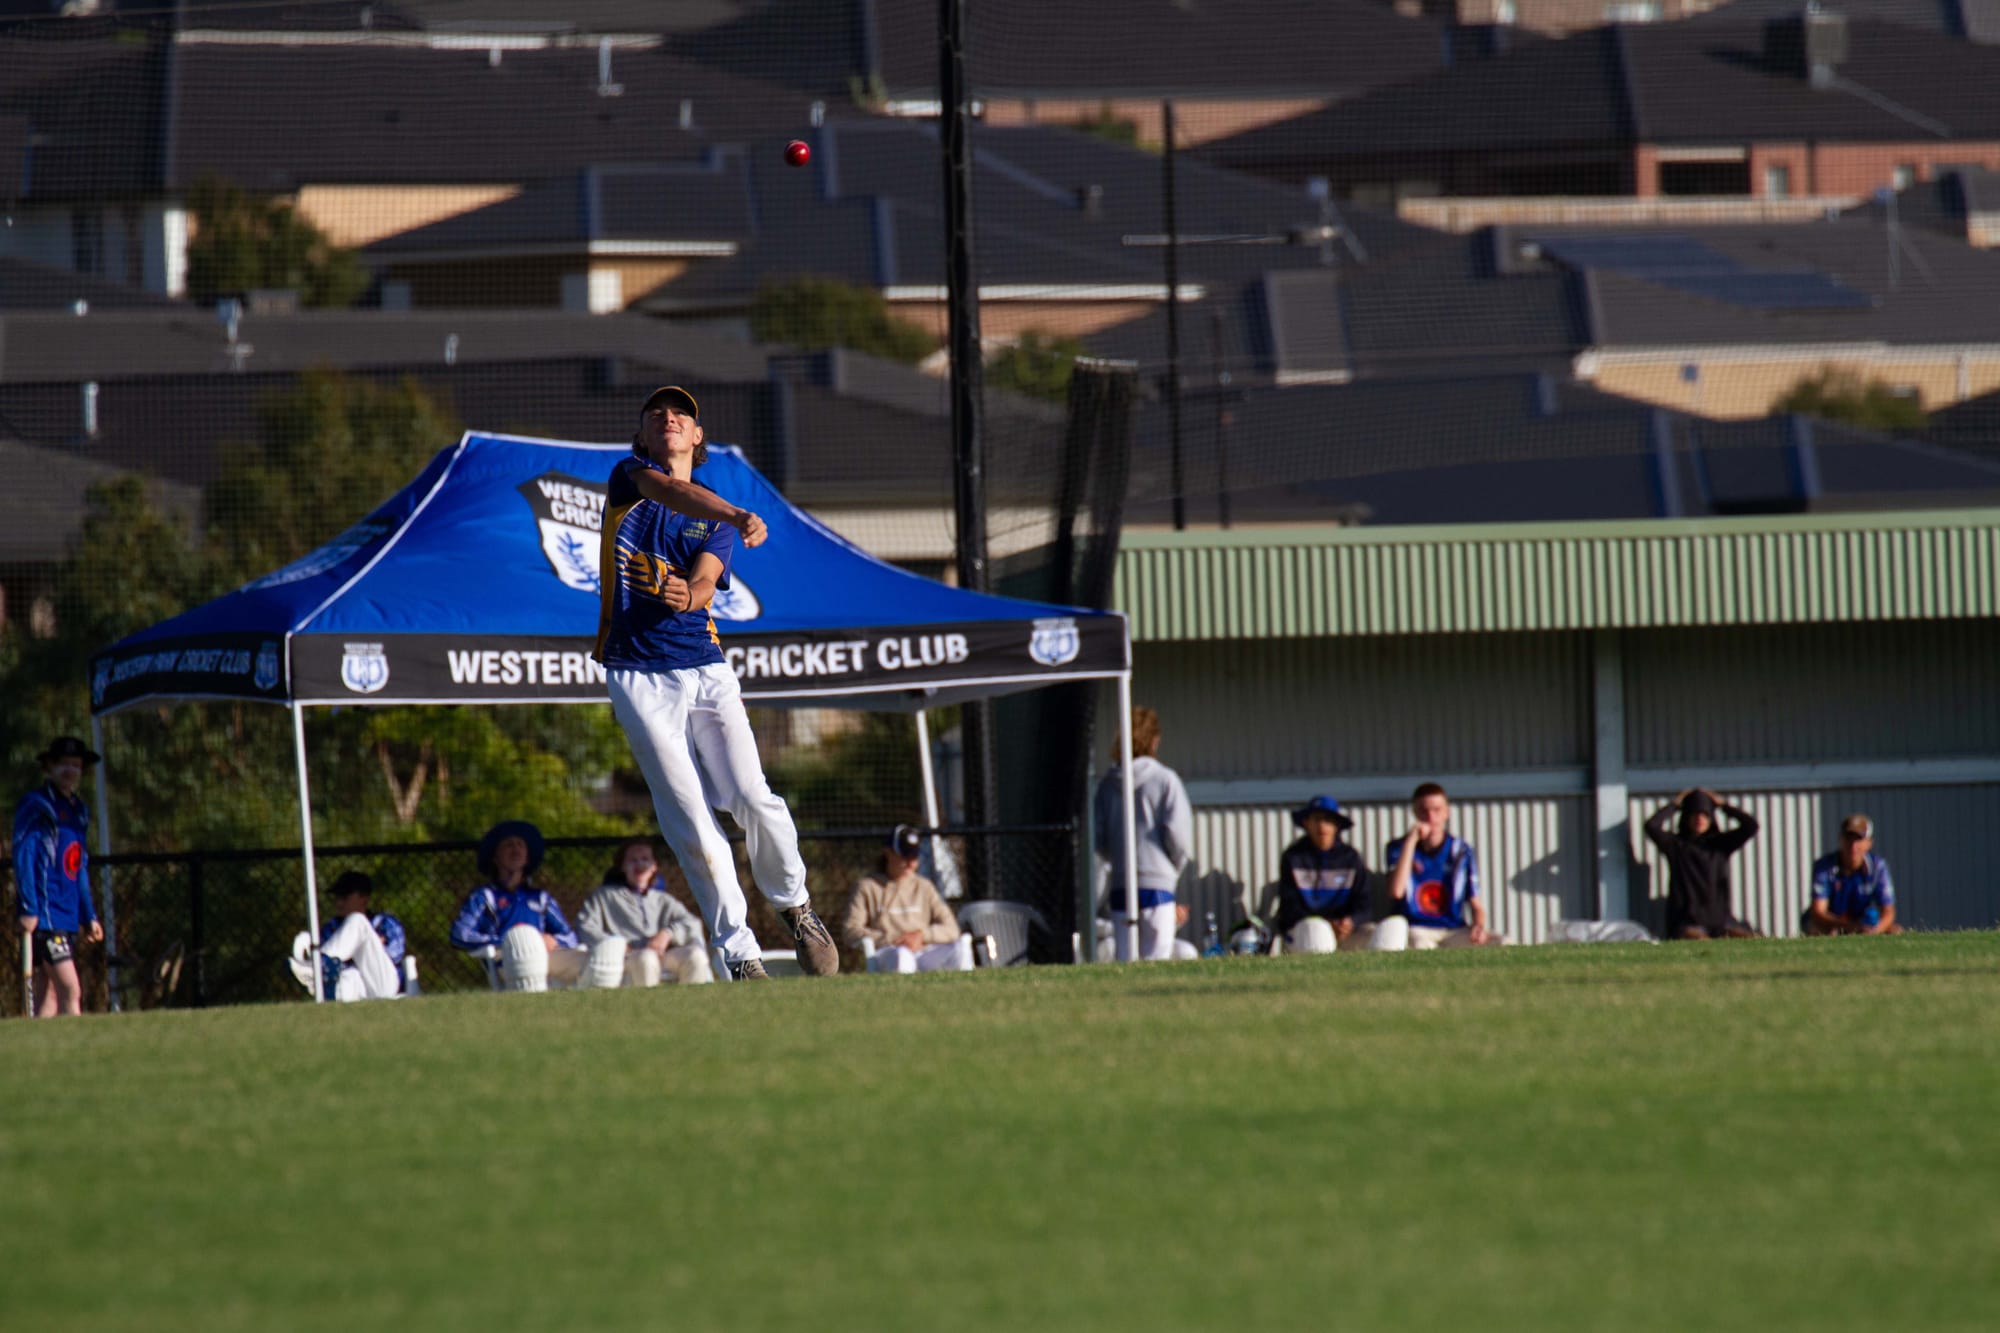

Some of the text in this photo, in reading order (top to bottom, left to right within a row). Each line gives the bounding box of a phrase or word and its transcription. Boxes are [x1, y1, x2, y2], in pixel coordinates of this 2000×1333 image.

[550, 499, 602, 530] CRIC
[726, 640, 869, 679] CRICKET
[877, 633, 969, 670] CLUB
